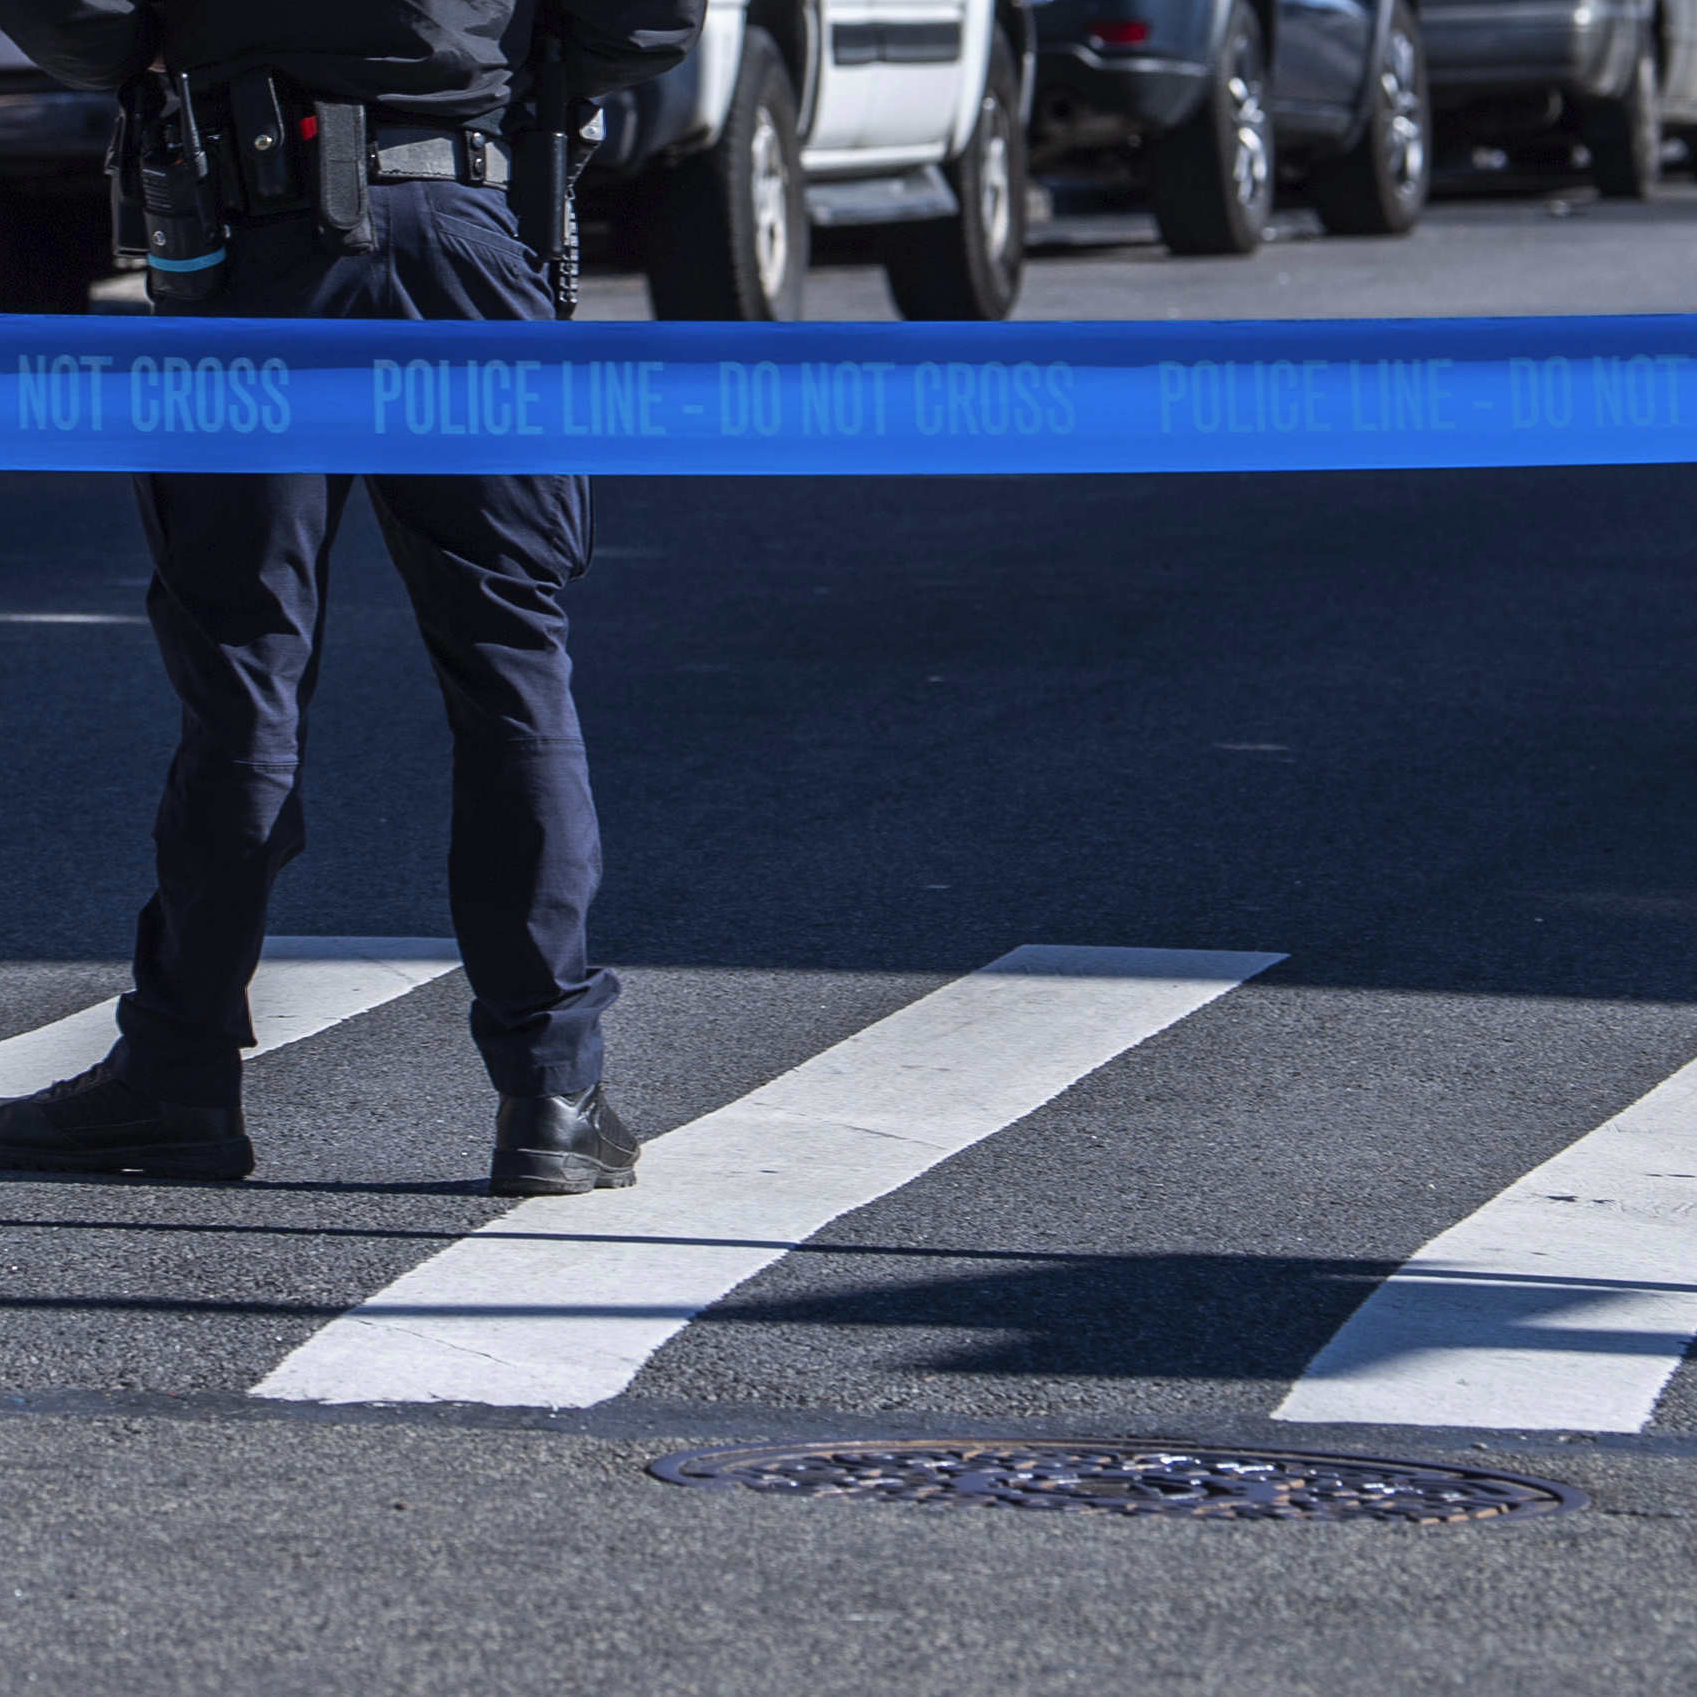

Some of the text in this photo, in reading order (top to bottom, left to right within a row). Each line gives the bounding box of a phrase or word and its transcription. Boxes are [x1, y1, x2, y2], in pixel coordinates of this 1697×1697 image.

[18, 354, 113, 431] NOT
[130, 356, 291, 434] CROSS
[373, 359, 543, 436] POLICE
[562, 361, 666, 437] LINE
[719, 360, 782, 437] DO
[801, 361, 895, 436] NOT
[914, 360, 1075, 437] CROSS
[1158, 359, 1330, 434] POLICE
[1350, 358, 1456, 432] LINE
[1509, 356, 1573, 429] DO
[1592, 354, 1689, 427] NOT
